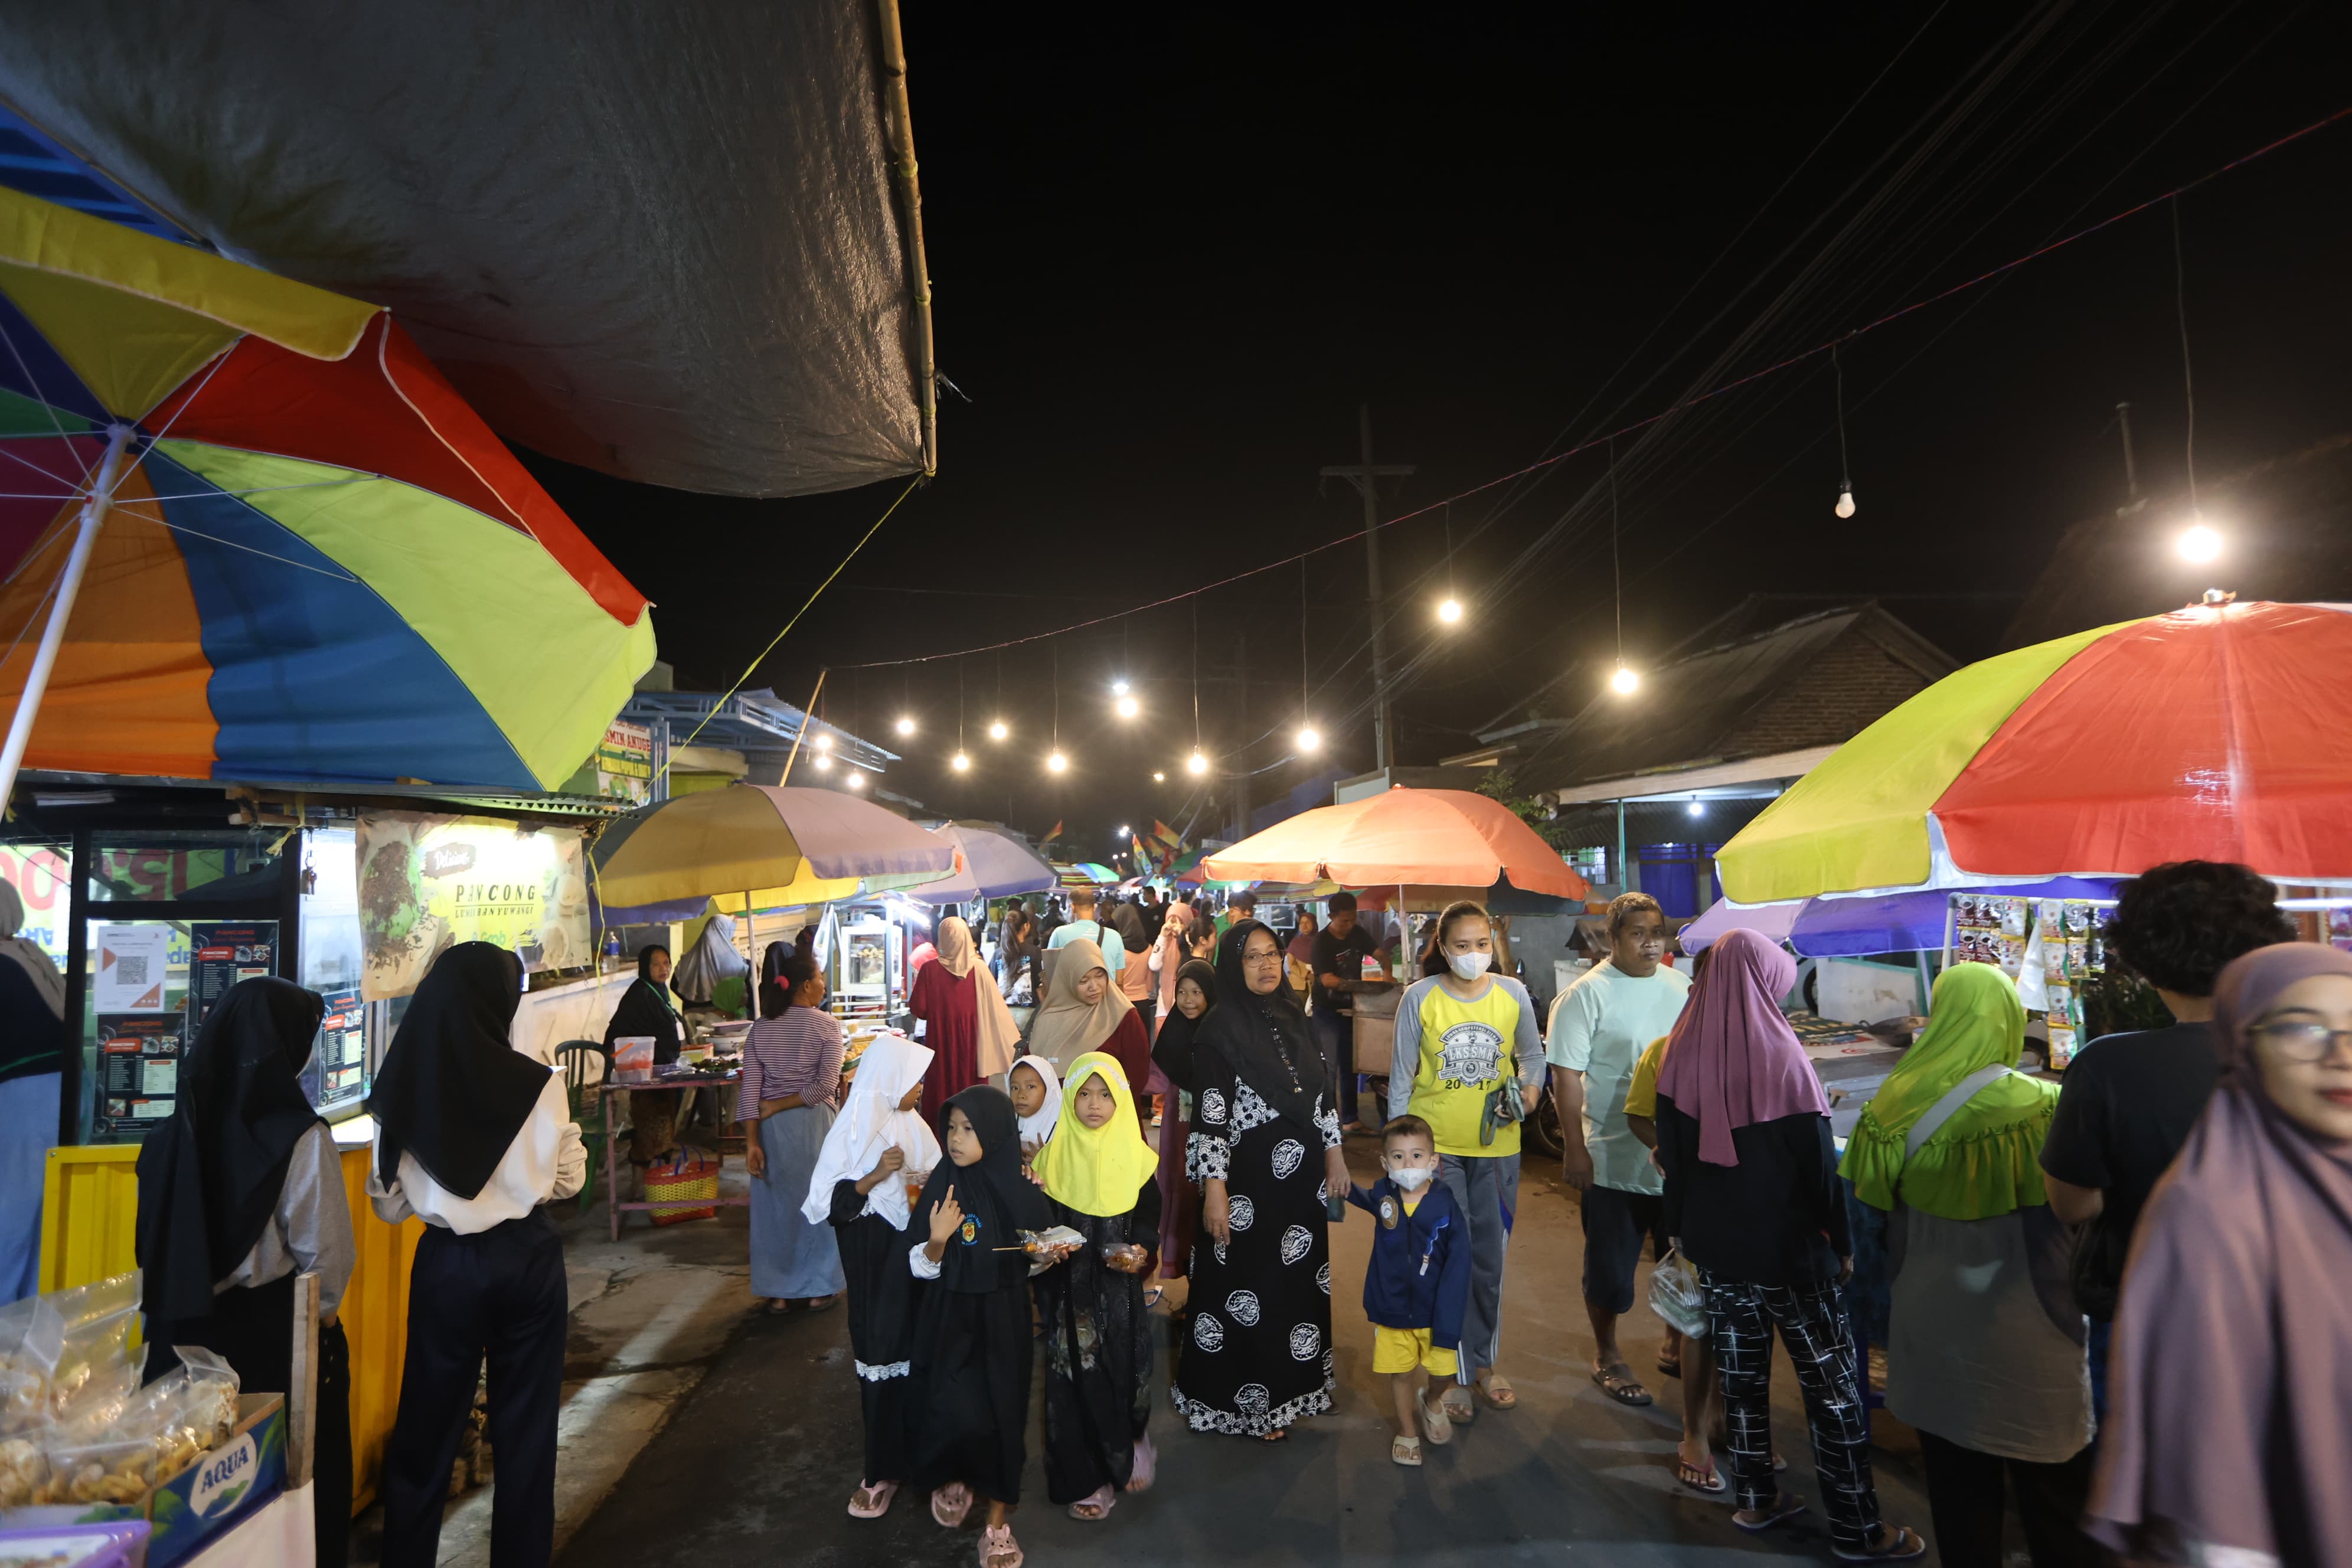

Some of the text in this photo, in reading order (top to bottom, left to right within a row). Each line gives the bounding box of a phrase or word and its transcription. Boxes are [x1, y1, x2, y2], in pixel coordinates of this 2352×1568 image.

[456, 885, 535, 902] PANCONG
[477, 907, 533, 916] BANYUWANGI
[1471, 1047, 1495, 1061] SMK
[1445, 1080, 1491, 1090] 20 17
[200, 1446, 249, 1494] AQUA
